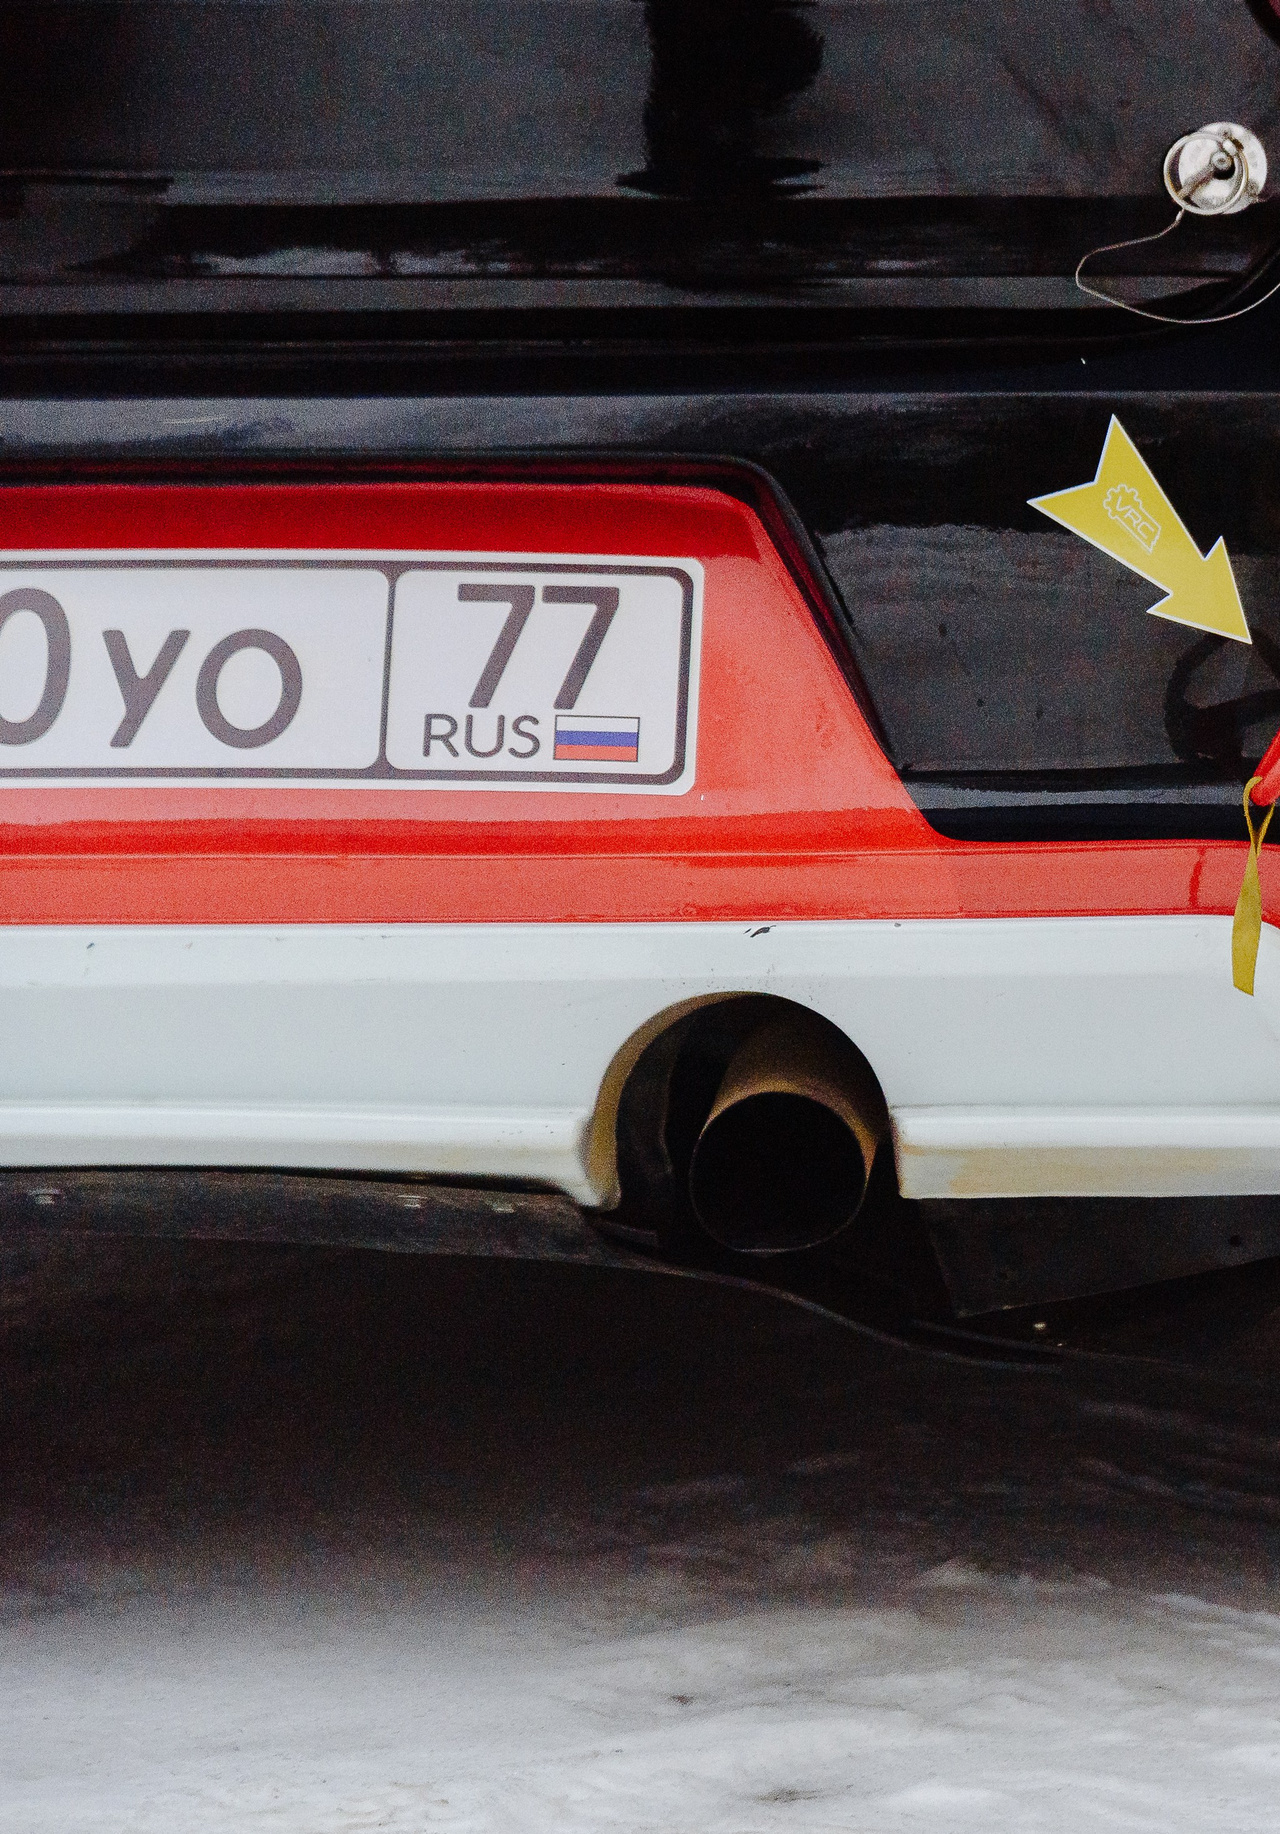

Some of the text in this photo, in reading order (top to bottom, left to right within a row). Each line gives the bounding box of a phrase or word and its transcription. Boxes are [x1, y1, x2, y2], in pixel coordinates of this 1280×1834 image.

[1116, 495, 1155, 539] VRC
[457, 583, 621, 710] 77
[422, 713, 541, 758] RUS
